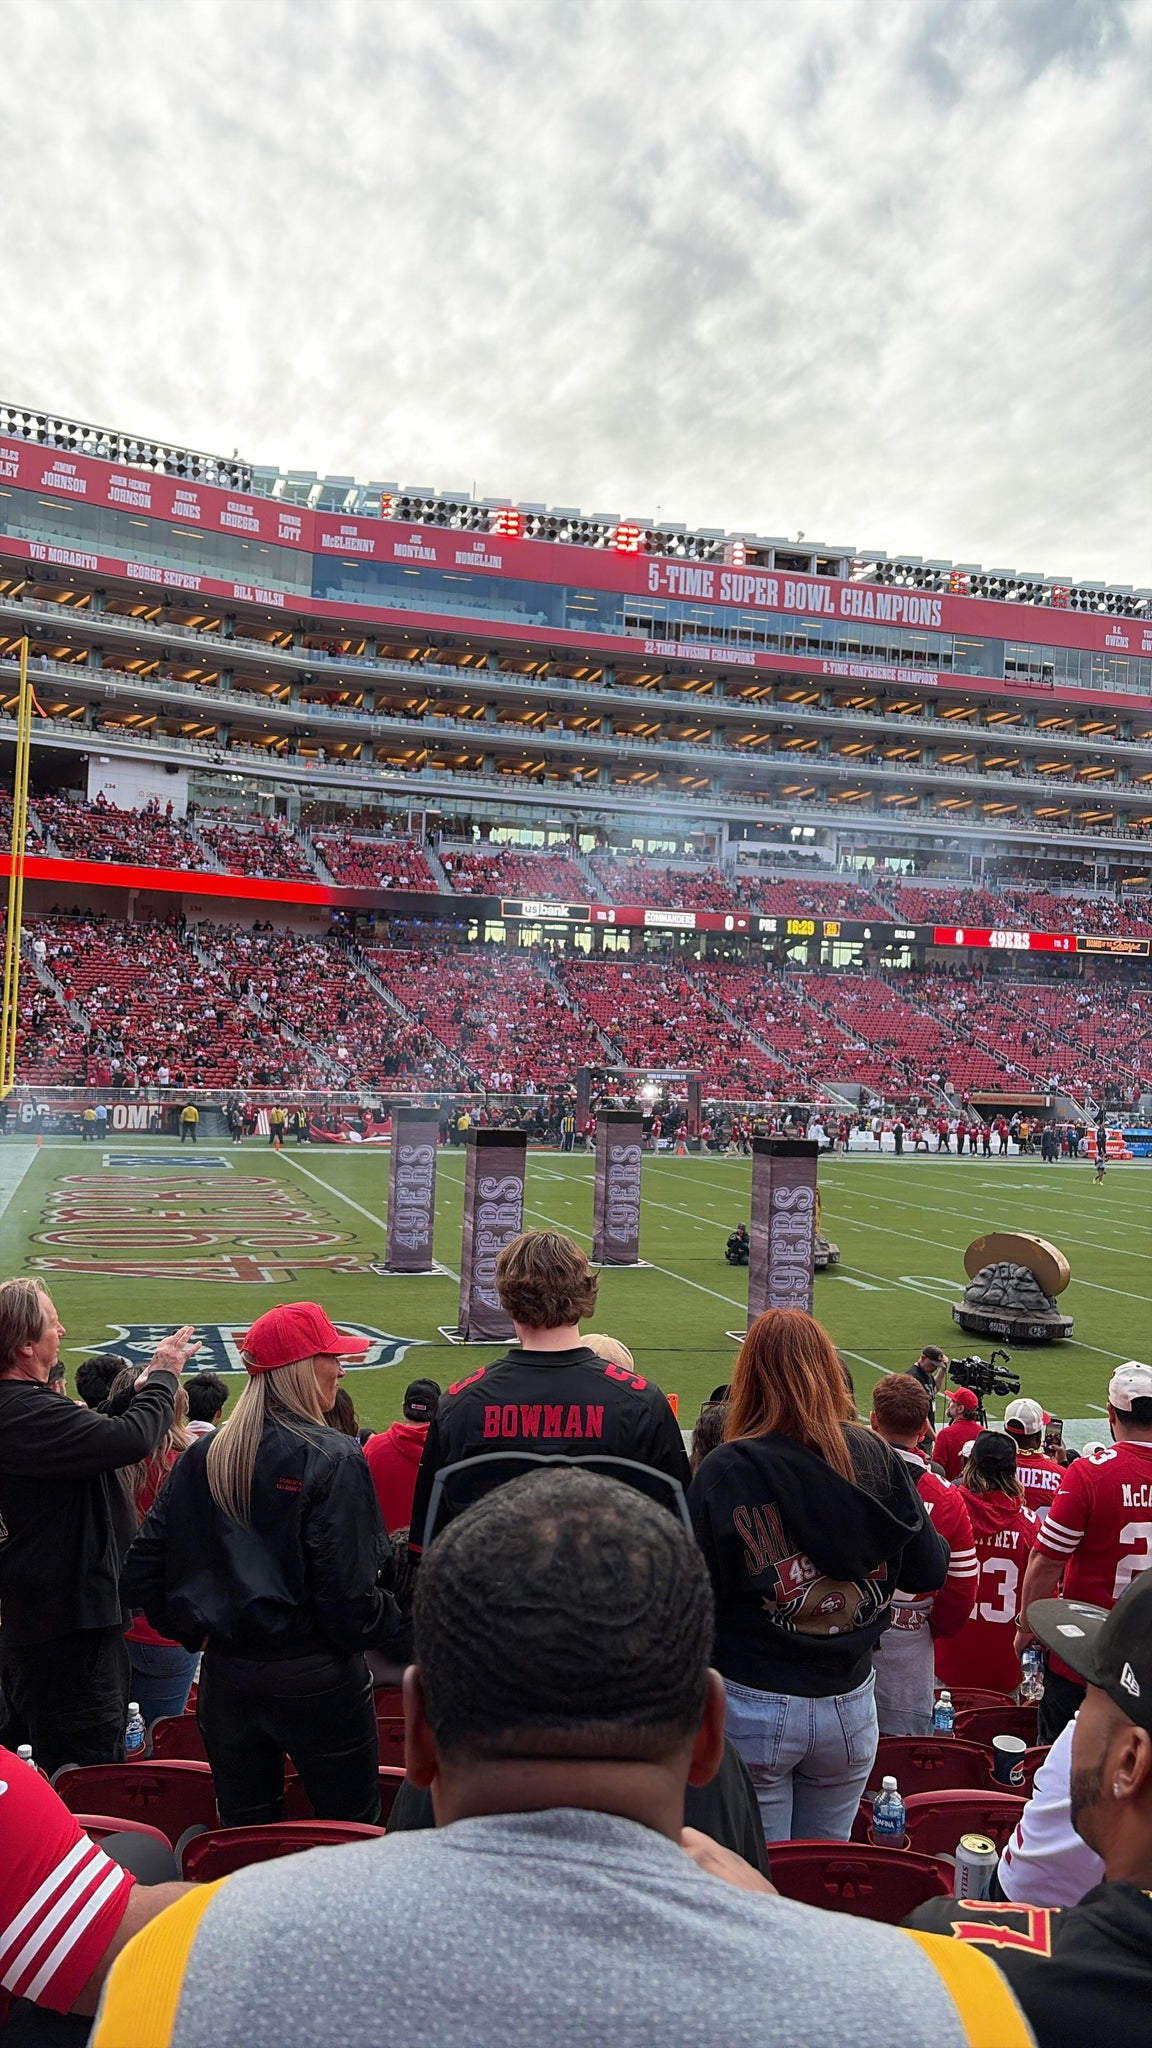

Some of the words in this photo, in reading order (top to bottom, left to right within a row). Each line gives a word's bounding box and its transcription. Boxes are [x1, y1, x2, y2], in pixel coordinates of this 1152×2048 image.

[41, 471, 87, 494] JOHNSON
[108, 486, 151, 509] JOHNSON
[171, 501, 201, 520] JONES
[220, 511, 260, 533] KRUEGER
[278, 524, 301, 541] LOTT
[322, 534, 375, 553] McELHENNY
[409, 534, 422, 544] JOE
[29, 543, 46, 560] VIC
[48, 547, 97, 570] MORABITO
[394, 543, 436, 561] MONTANA
[455, 551, 502, 569] NOMELLINI
[127, 563, 162, 582] GEORGE
[164, 571, 201, 590] SEIFERT
[233, 584, 253, 600] BILL
[255, 588, 284, 607] WALSH
[648, 563, 713, 598] 5-TIME
[720, 569, 778, 606] SUPER
[784, 582, 835, 613] BOWL
[840, 588, 942, 627] CHAMPIONS
[1105, 634, 1129, 648] OWENS
[644, 641, 676, 657] 22-TIME
[677, 645, 710, 661] DIVISION
[711, 649, 755, 665] CHAMPIONS
[822, 661, 849, 675] 8-TIME
[849, 664, 896, 681] CONFERENCE
[897, 670, 938, 686] CHAMPIONS
[524, 904, 539, 914] us
[540, 904, 570, 918] bank
[608, 910, 616, 923] 3
[645, 913, 696, 925] COMMANDERS
[724, 915, 734, 931] 0
[759, 918, 777, 932] PRE
[787, 919, 815, 936] 16:29
[955, 929, 964, 944] 0
[988, 931, 1030, 950] 49ERS
[1063, 938, 1069, 950] 3
[394, 1144, 435, 1251] 49ERS
[607, 1144, 641, 1244] 49ERS
[22, 1174, 380, 1283] 49ERS
[482, 1404, 606, 1440] BOWMAN
[732, 1502, 790, 1576] SAN
[969, 1557, 1019, 1624] 3
